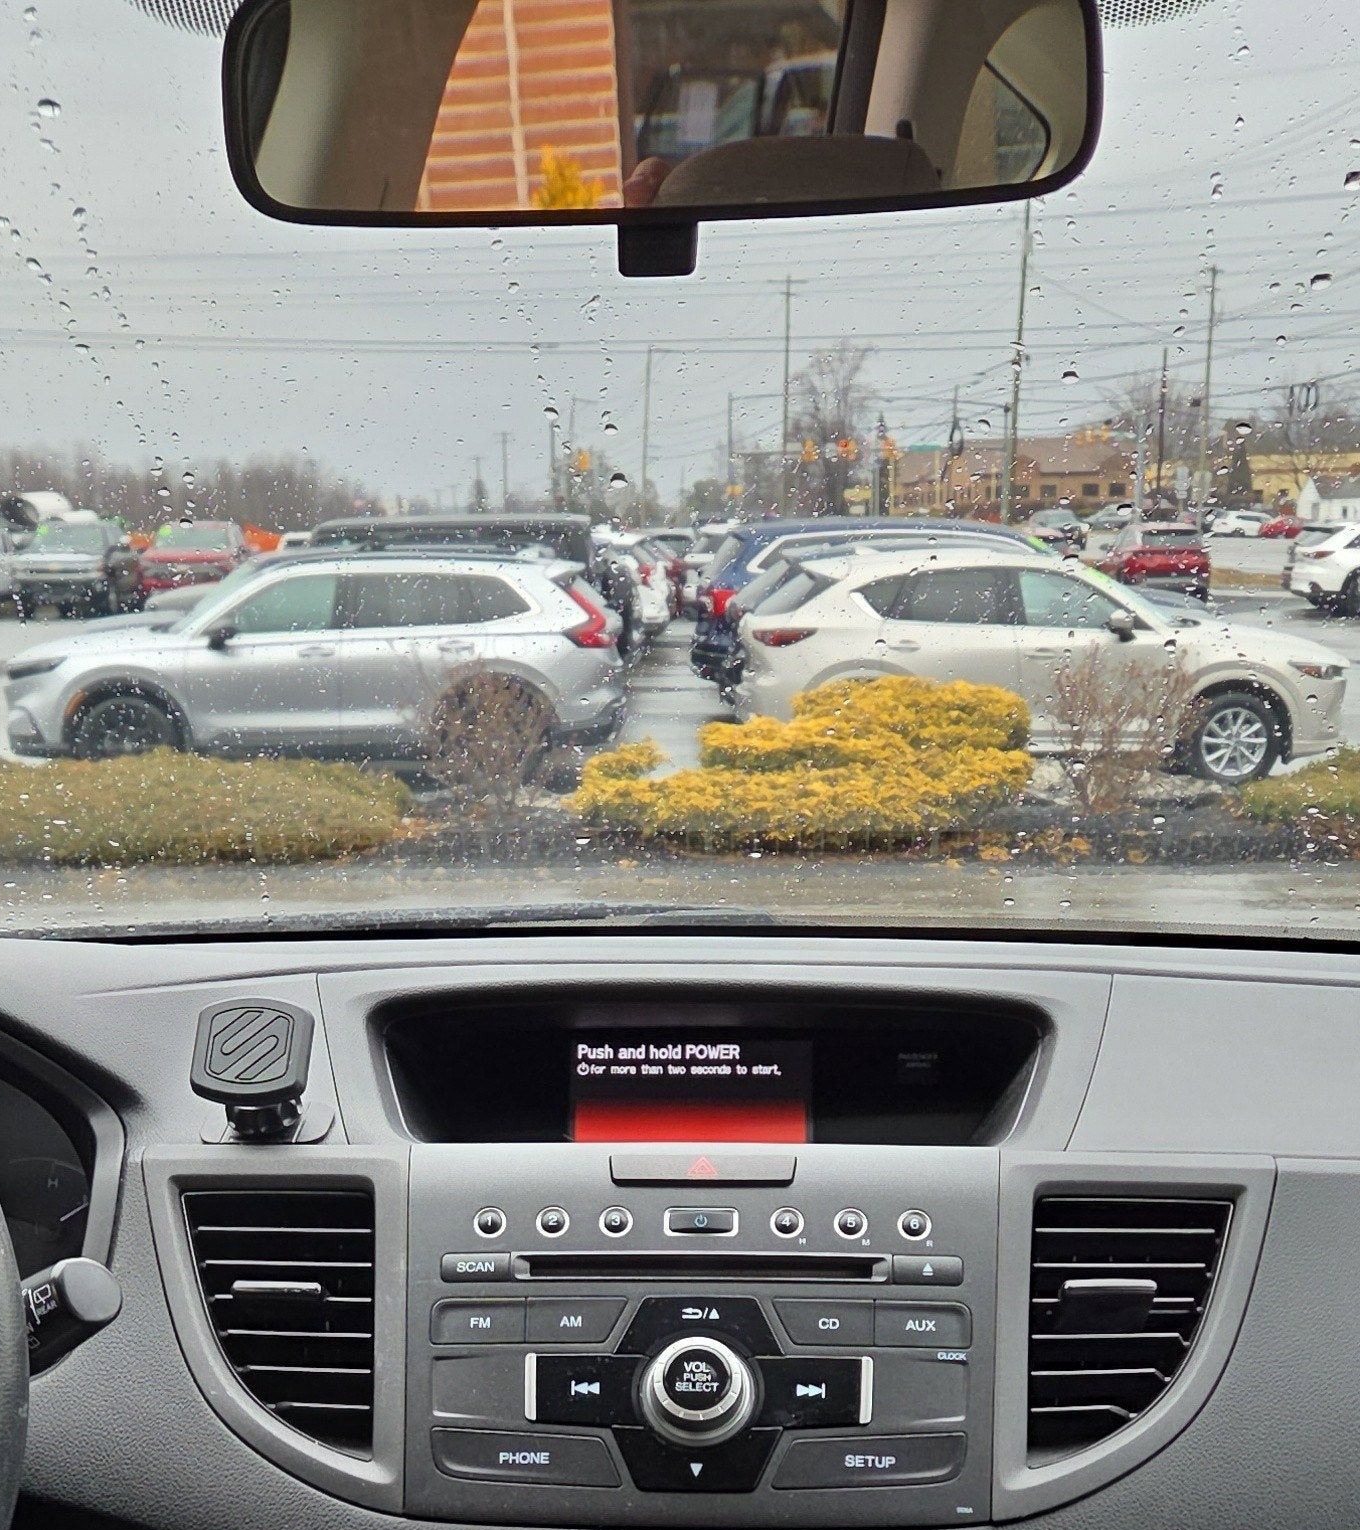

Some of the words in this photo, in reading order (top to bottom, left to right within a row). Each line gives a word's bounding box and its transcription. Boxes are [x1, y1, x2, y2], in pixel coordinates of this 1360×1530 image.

[577, 1044, 614, 1059] Push
[618, 1044, 646, 1059] and
[649, 1044, 682, 1059] hold
[685, 1045, 740, 1059] POWER
[590, 1064, 606, 1075] for
[610, 1066, 637, 1075] more
[641, 1064, 663, 1075] than
[667, 1064, 686, 1075] two
[690, 1064, 732, 1075] seconds
[736, 1064, 748, 1075] to
[486, 1216, 493, 1226] 1
[548, 1215, 558, 1226] 2
[611, 1215, 621, 1226] 3
[781, 1217, 791, 1227] 4
[846, 1217, 855, 1228] 5
[910, 1219, 920, 1229] 6
[456, 1261, 495, 1273] SCAN
[470, 1317, 491, 1328] FM
[560, 1316, 582, 1327] AM
[818, 1318, 840, 1330] CD
[905, 1320, 936, 1332] AUX
[937, 1352, 967, 1361] CLOCK
[683, 1361, 710, 1373] VOL
[683, 1373, 711, 1382] PUSH
[675, 1382, 719, 1393] SELECT
[499, 1452, 550, 1465] PHONE
[844, 1455, 896, 1469] SETUP
